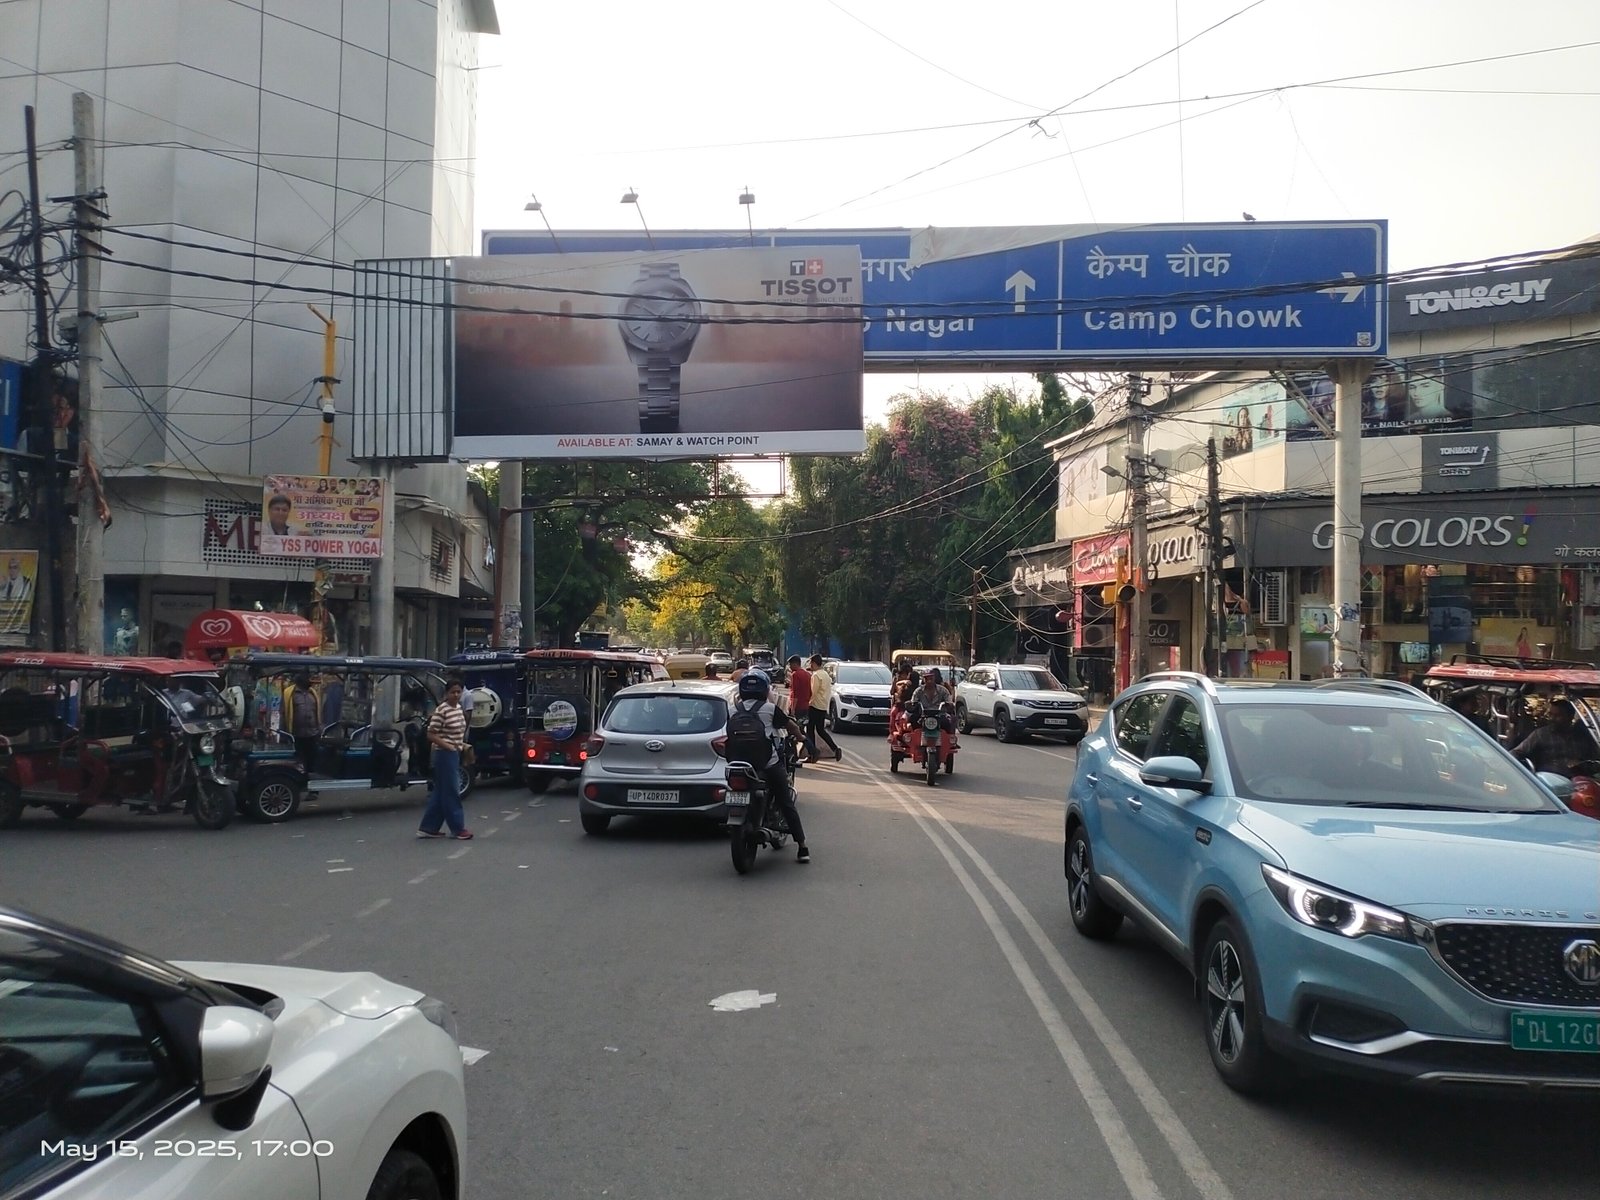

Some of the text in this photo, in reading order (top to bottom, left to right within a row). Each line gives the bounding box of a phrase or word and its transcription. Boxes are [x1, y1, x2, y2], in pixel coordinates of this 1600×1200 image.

[1086, 243, 1231, 279] कैम्प चौक
[761, 277, 852, 295] TISSOT
[1405, 278, 1553, 315] TONI&GUY
[886, 308, 975, 338] Nagar
[1084, 304, 1302, 335] Camp Chowk
[558, 436, 760, 447] AVAILABLE AT: SAMAY & WATCH POINT
[298, 511, 345, 520] अध्यक्ष
[281, 539, 378, 555] YSS POWER YOGA
[1554, 544, 1571, 557] गो
[1149, 623, 1168, 637] GO
[466, 652, 497, 660] सारथी
[1465, 907, 1569, 918] MORRIS
[1529, 1021, 1600, 1045] DL 12G
